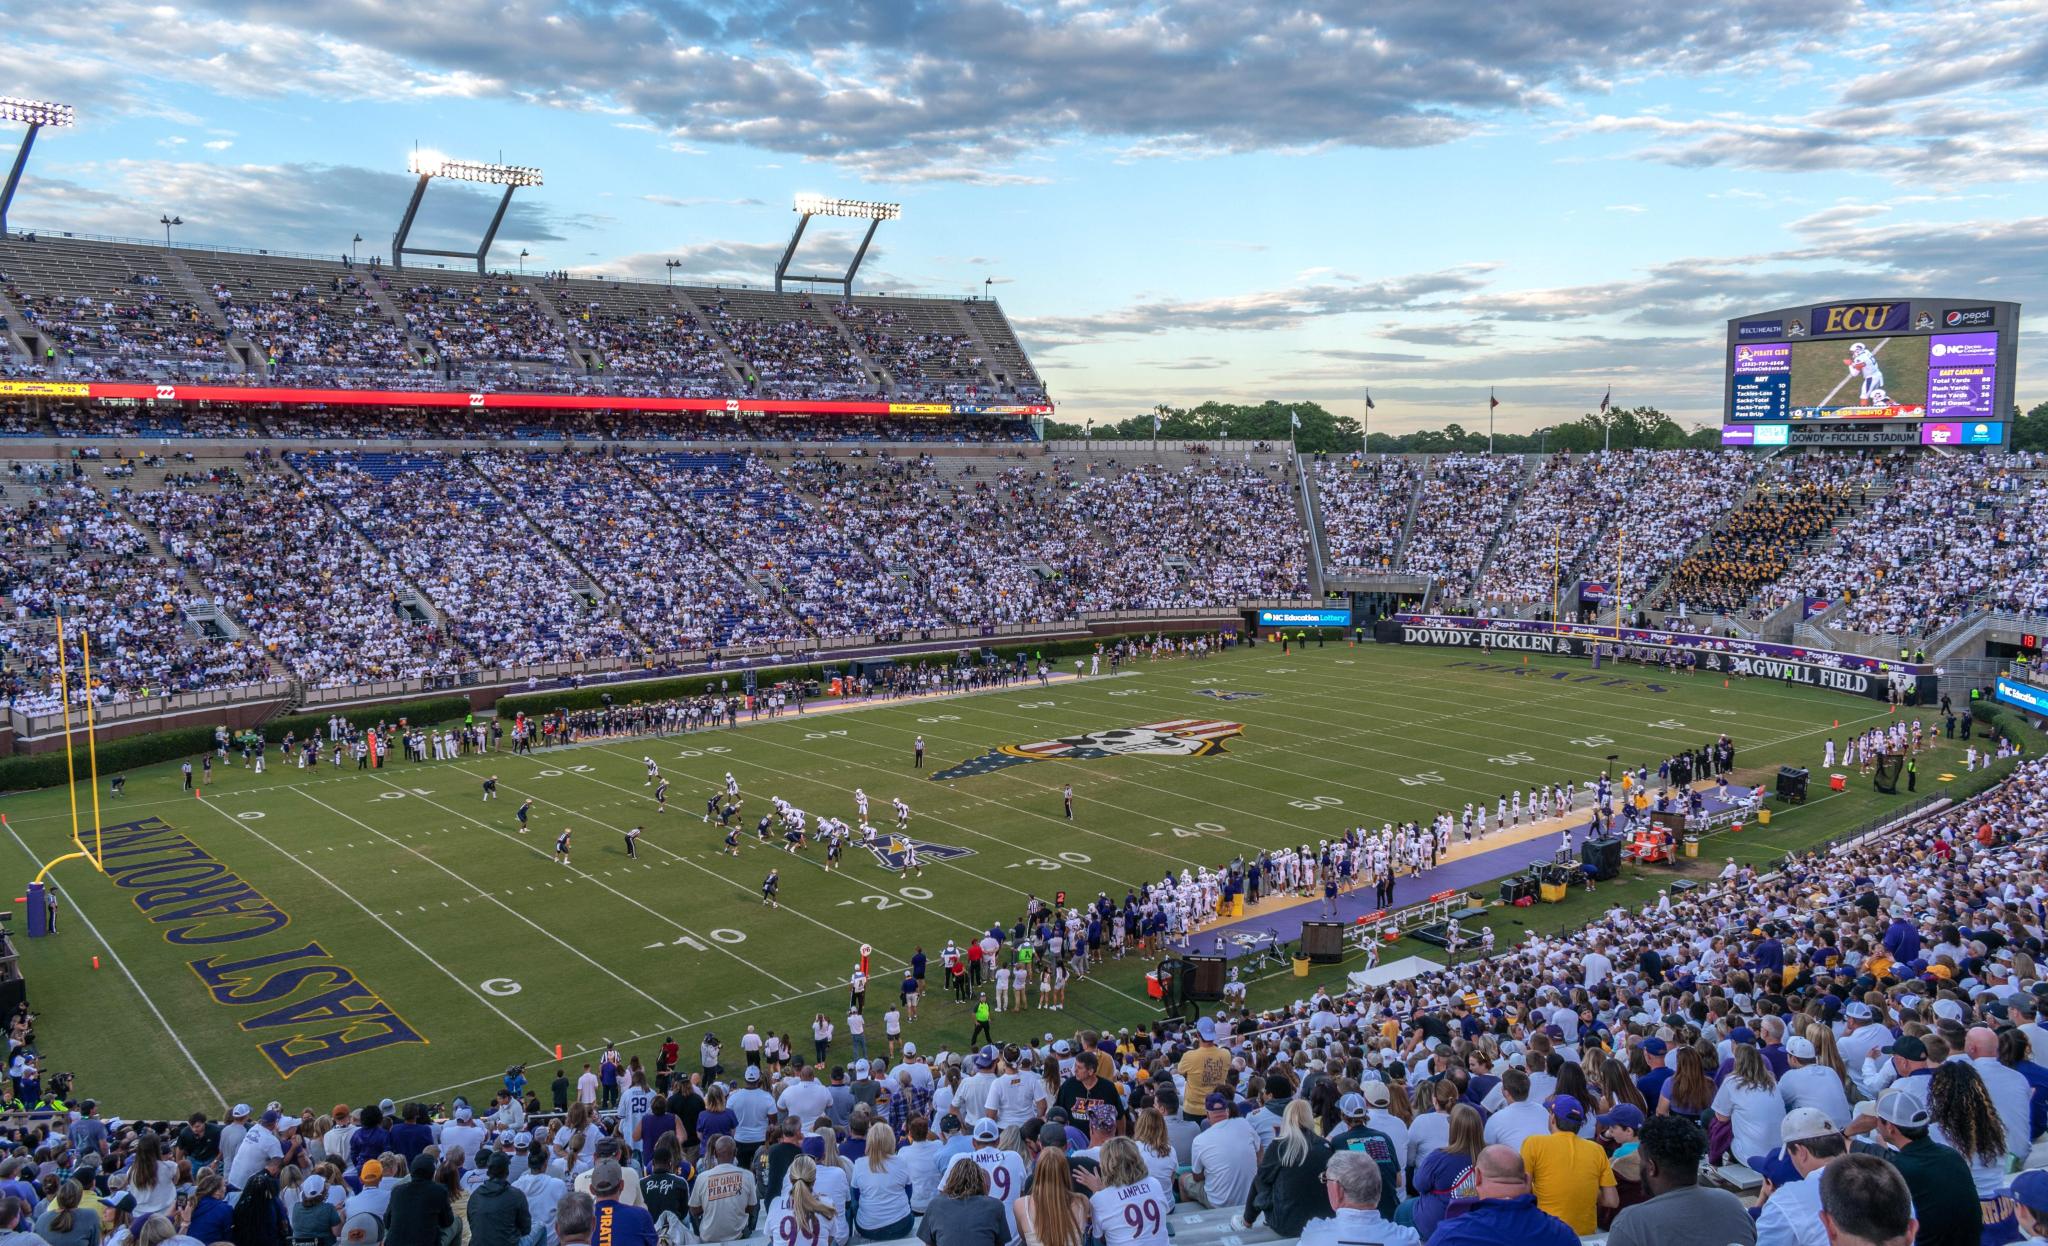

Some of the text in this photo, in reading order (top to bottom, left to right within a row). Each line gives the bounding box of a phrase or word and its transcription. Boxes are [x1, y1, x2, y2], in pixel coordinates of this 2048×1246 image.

[1824, 305, 1892, 332] ECU
[1963, 310, 1989, 320] pepsi
[1947, 345, 1964, 354] NC
[1792, 433, 1870, 442] DOWDY-FICKLEN
[1873, 433, 1915, 442] STADIUM
[1284, 613, 1320, 622] Education
[1320, 614, 1346, 623] Lottery
[1404, 628, 1554, 653] DOWDY-FICKLEN
[2024, 635, 2034, 647] 18
[1616, 644, 1697, 666] BNEYAD
[1729, 654, 1868, 693] BAGWELL FIELD
[1488, 753, 1536, 766] 30
[1398, 773, 1446, 787] 40
[1288, 796, 1344, 811] 50
[1171, 822, 1228, 839] 40
[1025, 852, 1092, 871] 30
[860, 886, 934, 911] 20
[66, 815, 430, 1081] EAST CAROLINA
[672, 928, 747, 951] 10
[480, 977, 522, 996] G
[631, 1096, 648, 1113] 29
[708, 1175, 742, 1188] EAST CAROLINA
[708, 1183, 742, 1197] PIRATES
[1117, 1183, 1151, 1200] LAMPLEY
[600, 1206, 613, 1246] PIRAT
[1124, 1198, 1160, 1239] 99
